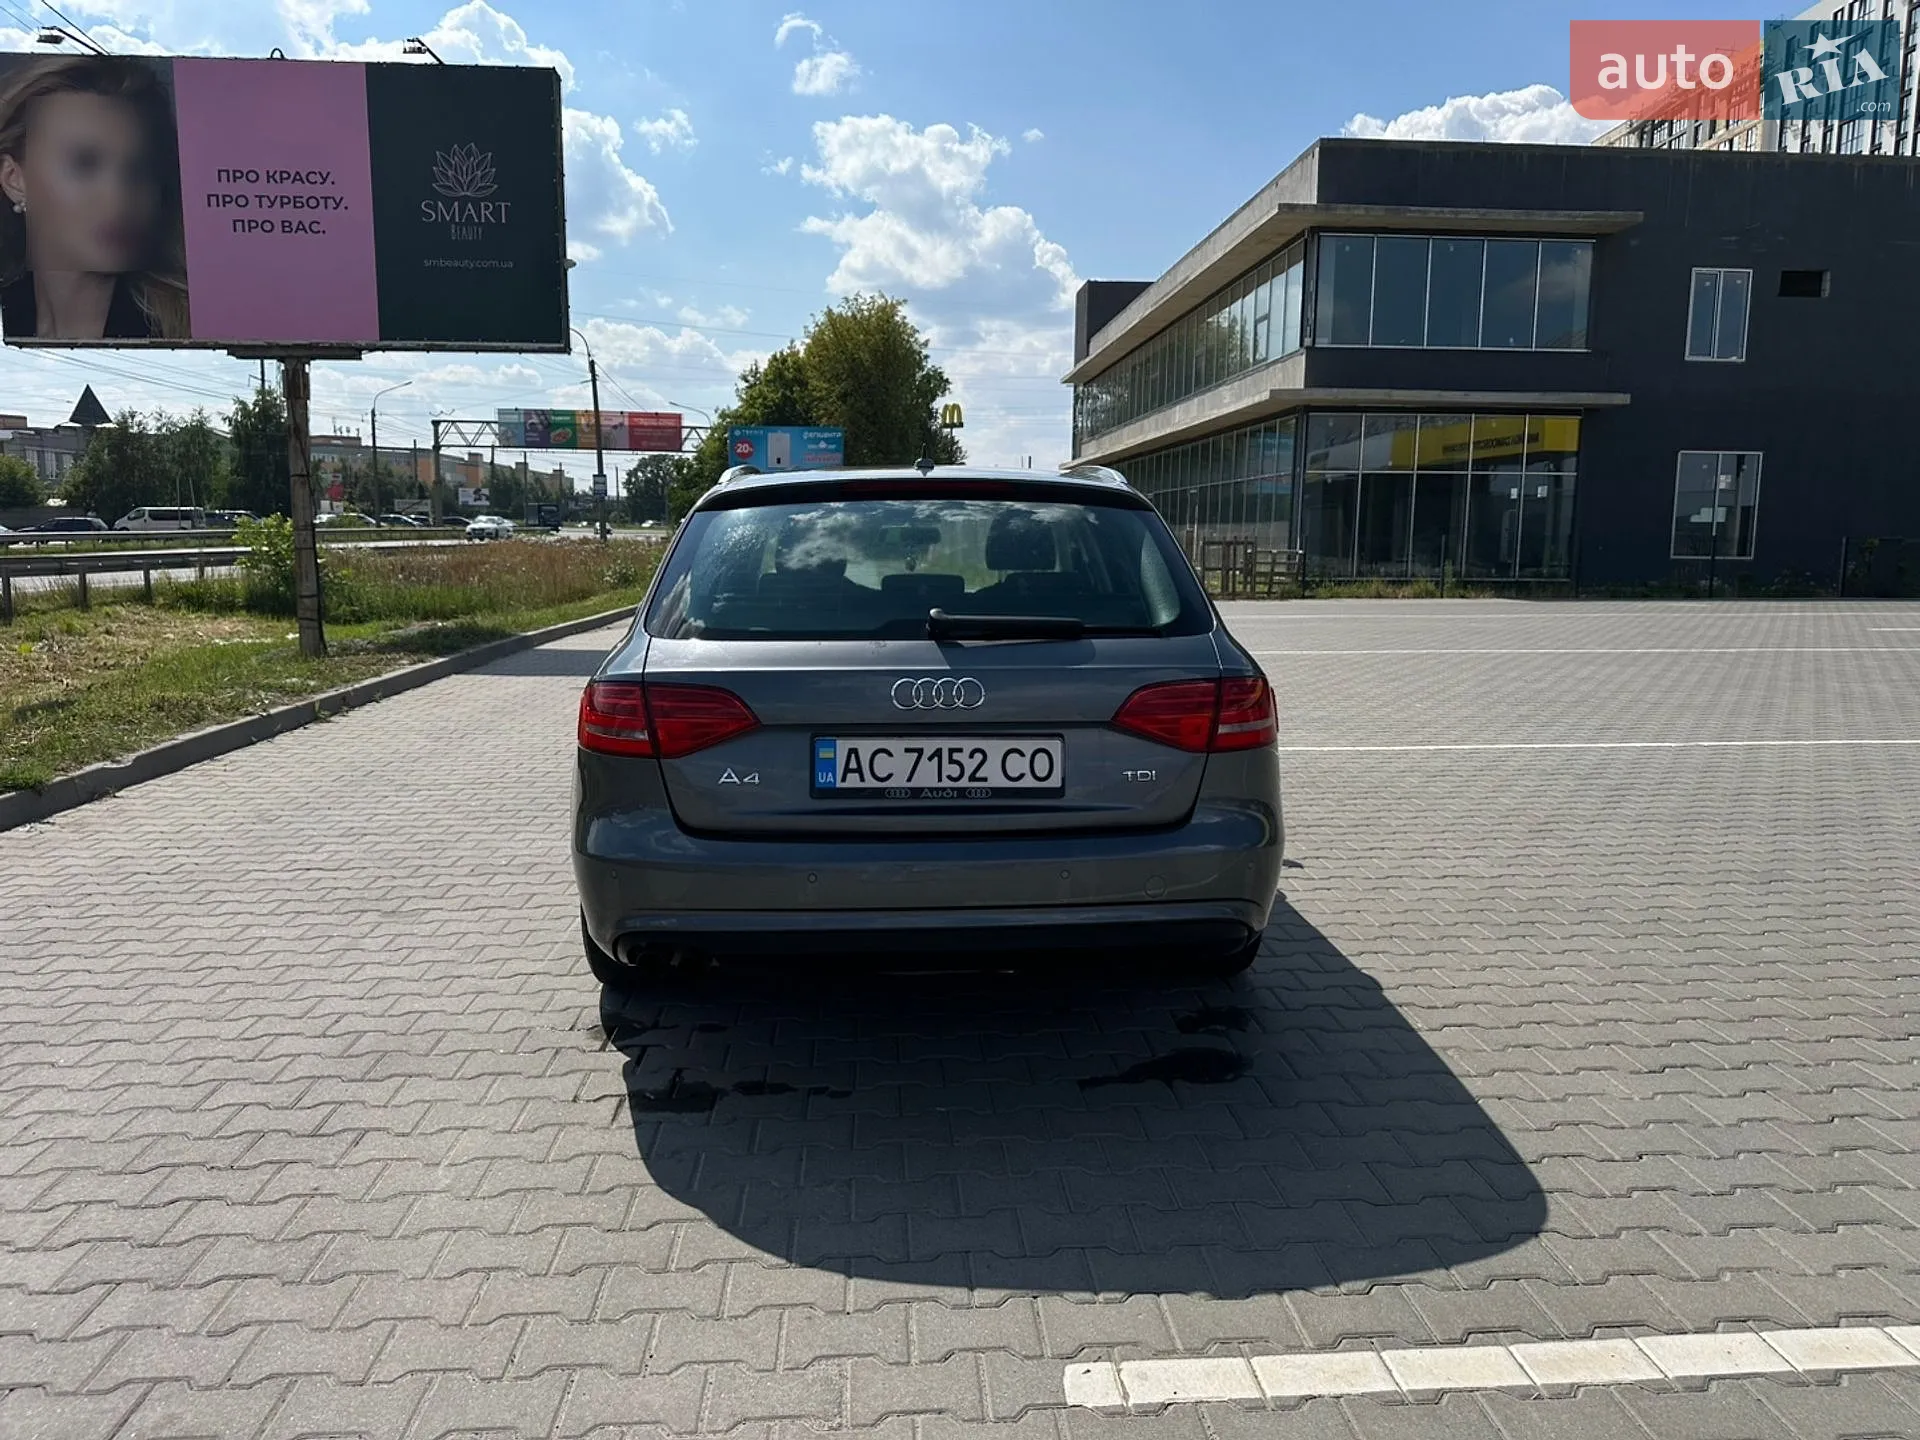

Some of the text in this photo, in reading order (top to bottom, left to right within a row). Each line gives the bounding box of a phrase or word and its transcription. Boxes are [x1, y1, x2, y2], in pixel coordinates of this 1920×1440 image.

[217, 168, 335, 185] ПРО КРАСУ.
[206, 193, 348, 210] ПРО ТУРБОТУ.
[421, 199, 511, 223] SMART
[232, 218, 326, 235] ПРО ВАС.
[450, 223, 483, 241] BEAUTY
[423, 257, 514, 270] smbeauty.com.ua
[840, 747, 1054, 784] AC 7152 CO
[718, 767, 760, 784] A4
[818, 771, 834, 784] UA
[1122, 769, 1156, 781] TDI
[920, 788, 958, 798] Audi
